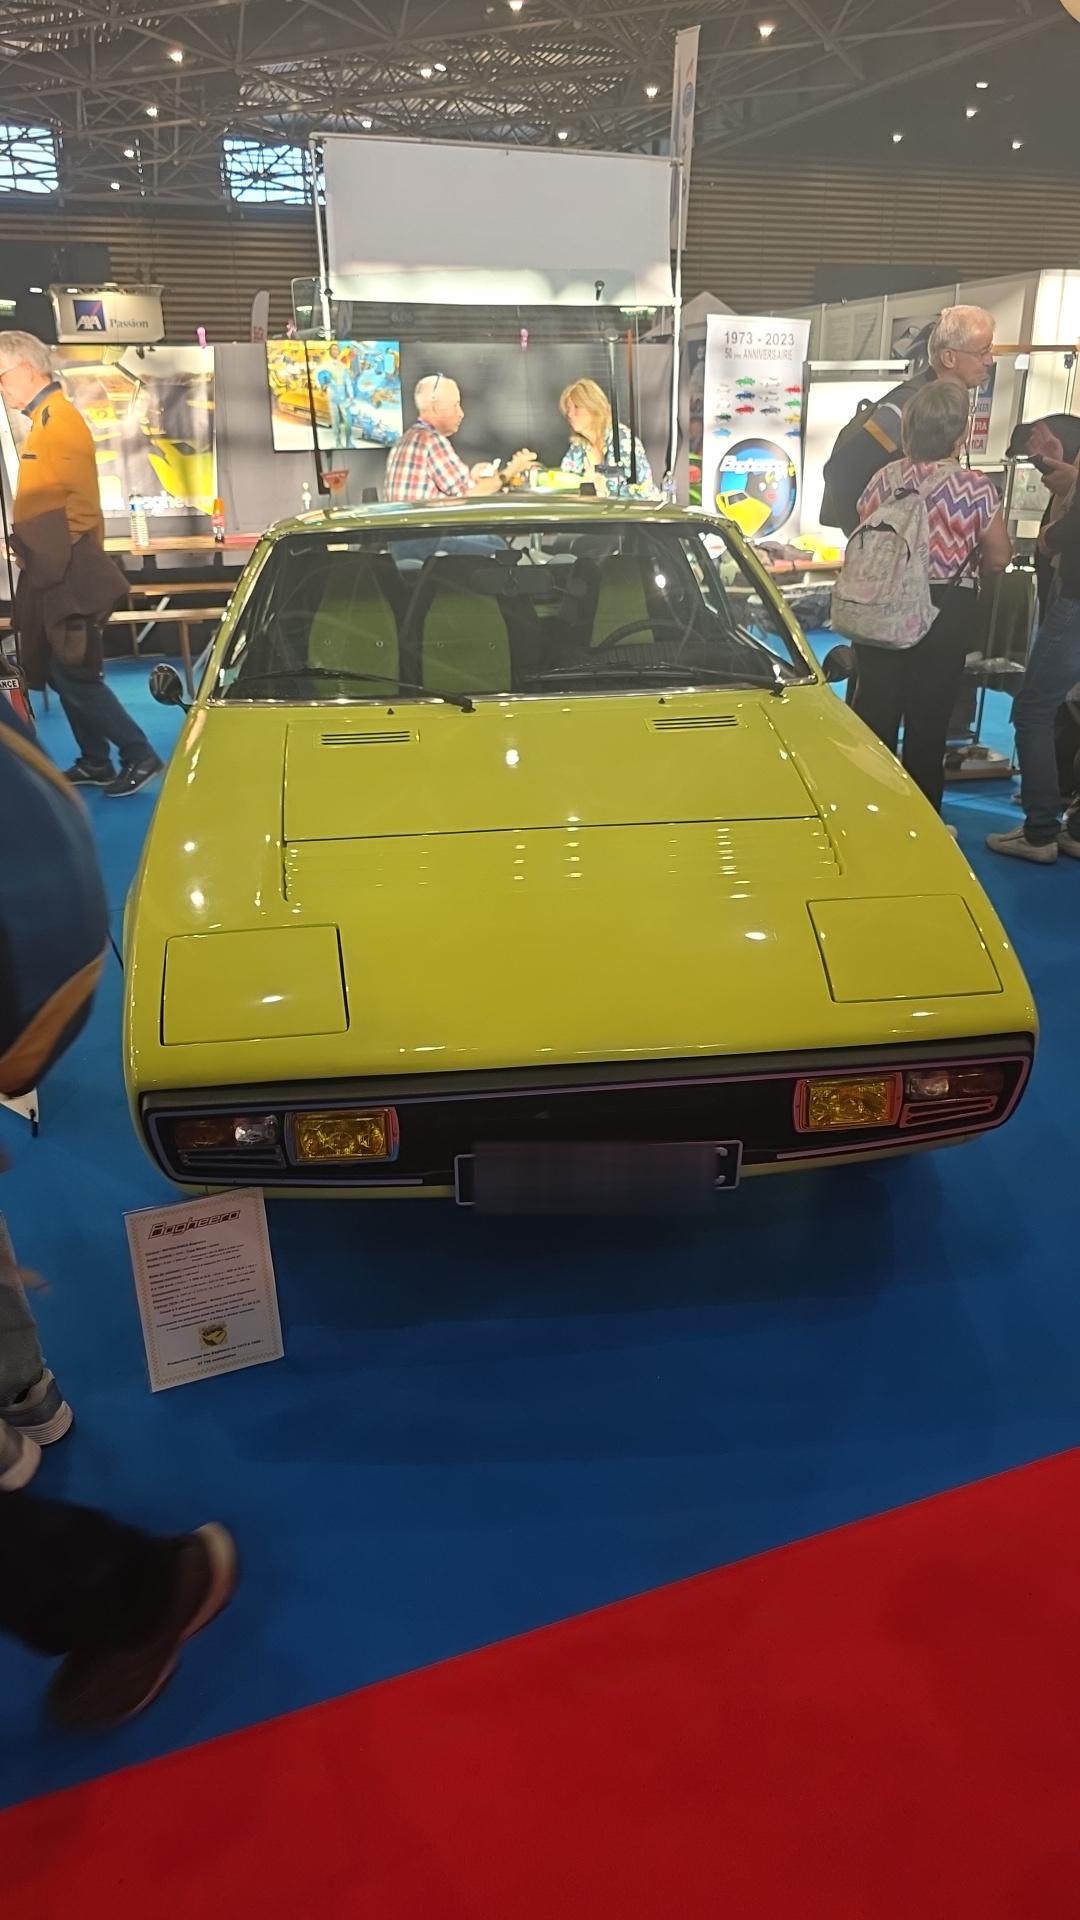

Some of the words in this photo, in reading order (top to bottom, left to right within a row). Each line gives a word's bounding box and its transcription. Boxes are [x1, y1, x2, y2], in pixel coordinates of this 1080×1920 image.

[77, 315, 103, 330] AXA
[109, 318, 149, 329] Passion
[725, 331, 753, 345] 1973
[765, 332, 795, 346] 2023
[743, 348, 793, 361] ANNIVERSAIRE
